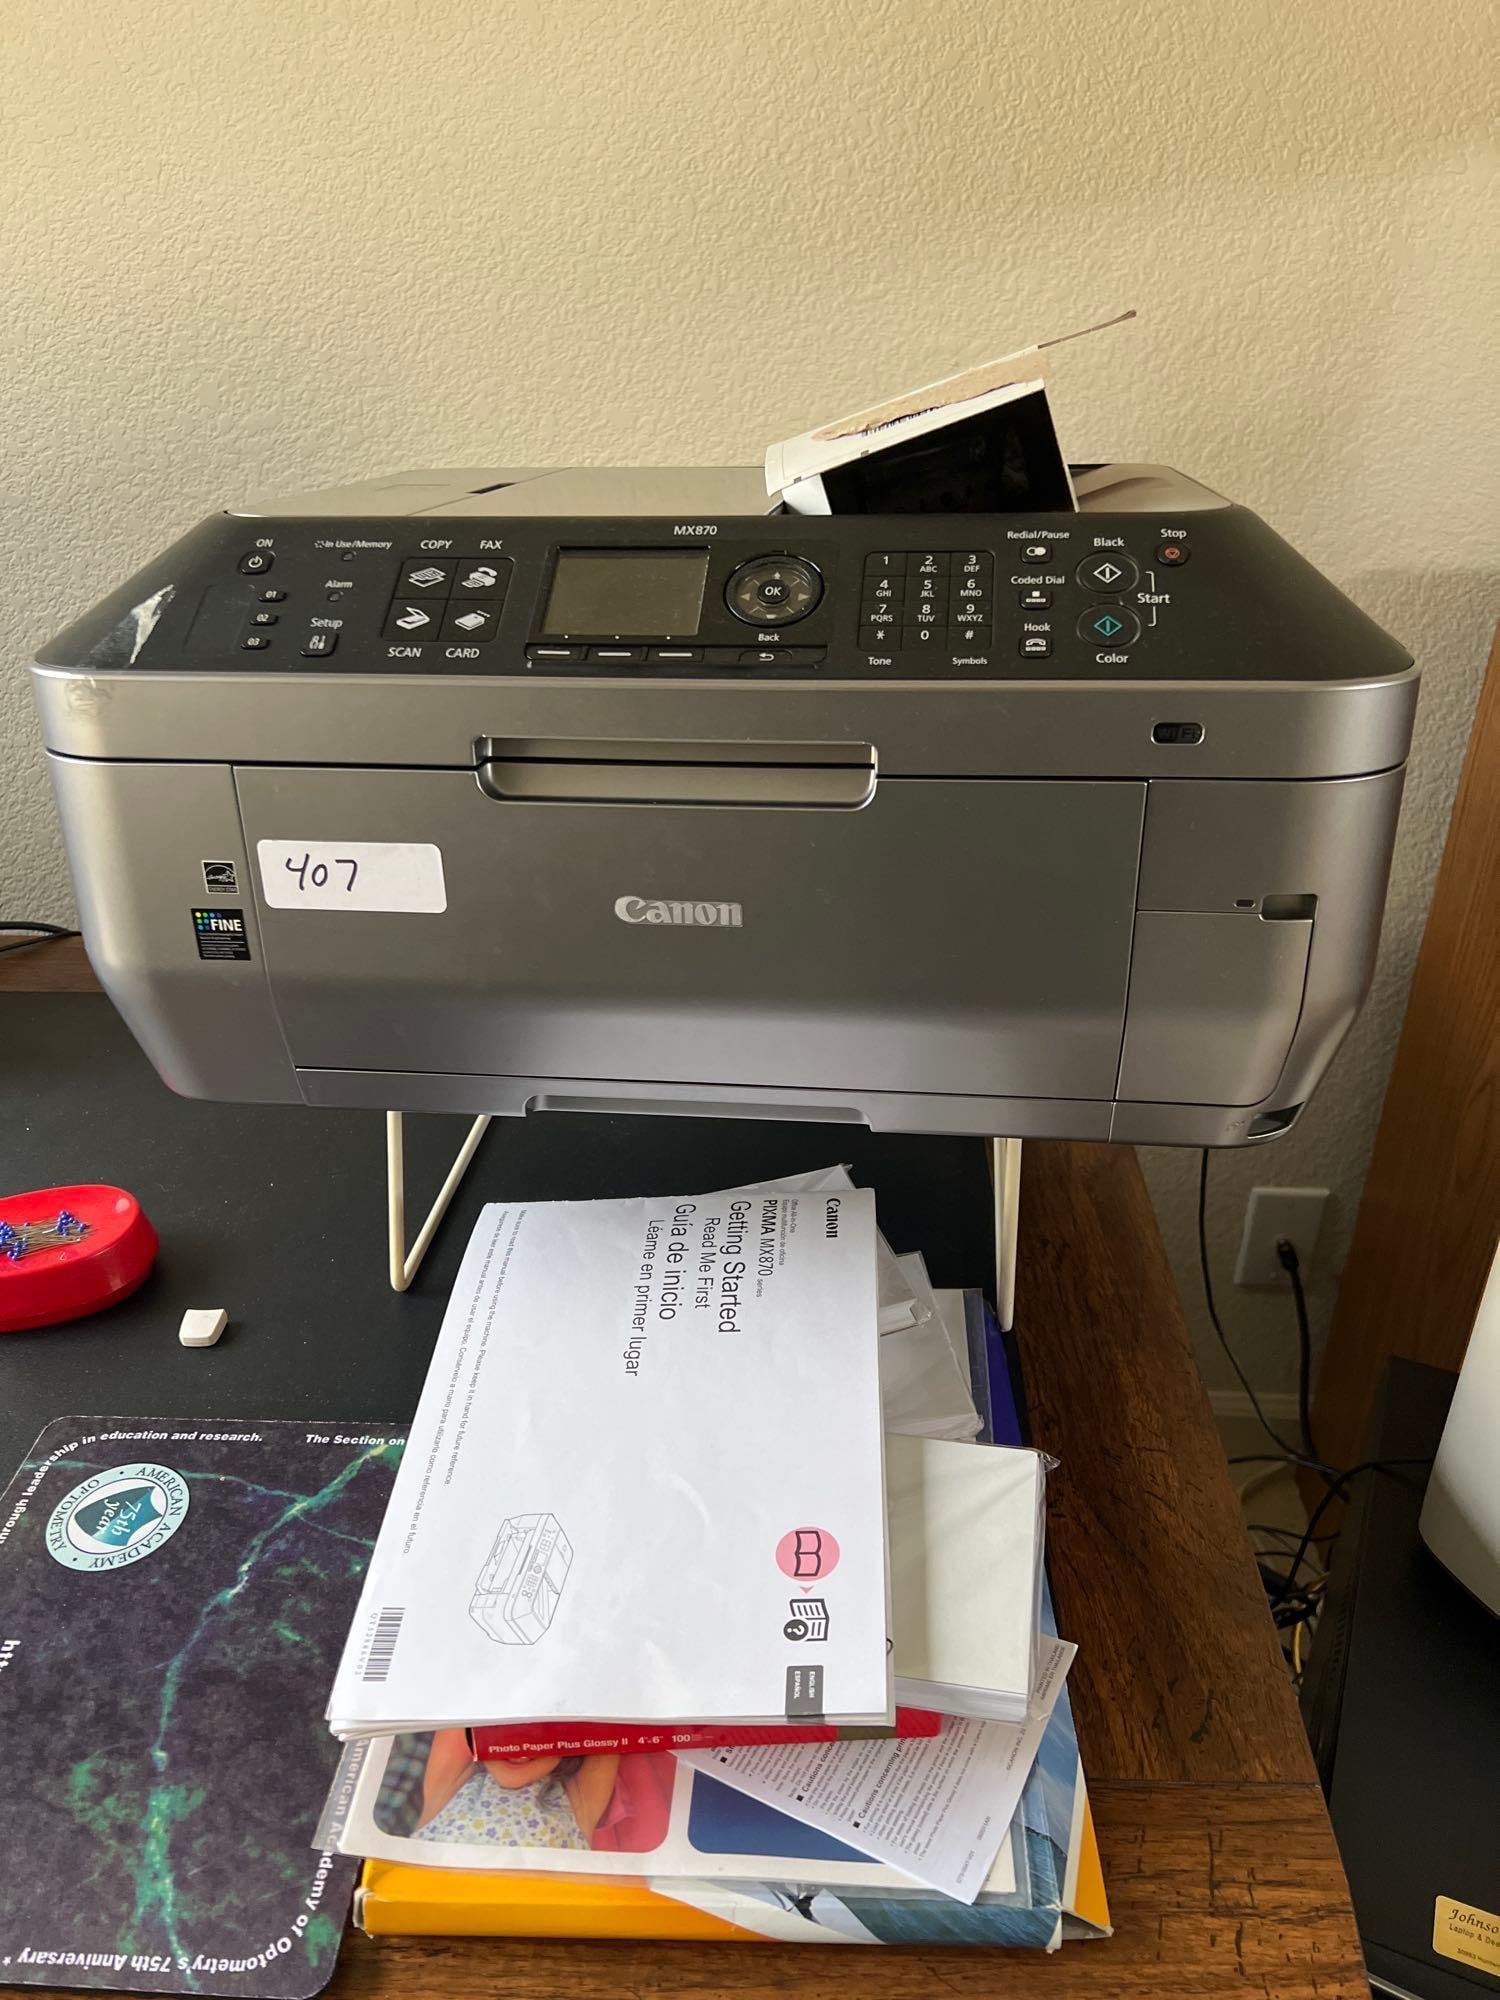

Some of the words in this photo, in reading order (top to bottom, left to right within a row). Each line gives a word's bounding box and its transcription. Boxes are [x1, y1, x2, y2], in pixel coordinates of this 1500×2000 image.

[673, 525, 718, 536] MX870
[1007, 530, 1070, 539] Redial/Pause
[1161, 528, 1187, 539] Stop
[253, 538, 273, 548] ON
[420, 540, 453, 550] COPY
[480, 540, 503, 550] FAX
[1094, 537, 1125, 547] Black
[883, 555, 889, 565] 1
[925, 555, 933, 565] 2
[968, 555, 977, 565] 3
[920, 565, 938, 573] ABC
[964, 565, 980, 573] DEF
[325, 580, 353, 589] Alarm
[880, 579, 888, 589] 4
[924, 580, 932, 590] 5
[967, 579, 976, 589] 6
[1011, 576, 1042, 585] Coded
[1045, 576, 1065, 585] Dial
[765, 586, 782, 596] OK
[876, 590, 892, 598] GHI
[920, 590, 935, 598] JKL
[1137, 593, 1170, 604] Start
[880, 604, 887, 614] 7
[922, 604, 931, 614] 8
[966, 604, 975, 614] 9
[310, 617, 343, 630] Setup
[871, 614, 893, 623] PQRS
[918, 615, 935, 623] TUV
[957, 614, 983, 622] WXYZ
[1024, 623, 1051, 632] Hook
[758, 633, 780, 642] Back
[387, 647, 422, 658] SCAN
[446, 648, 480, 659] CARD
[868, 656, 892, 666] Tone
[952, 656, 988, 666] Symbols
[1096, 653, 1129, 664] Color
[286, 853, 358, 891] 407
[615, 895, 743, 926] Canon
[211, 918, 243, 932] FINE
[671, 1203, 697, 1237] Guía
[761, 1199, 778, 1235] PIXMA
[826, 1198, 841, 1239] Canon
[702, 1217, 721, 1248] Read
[720, 1200, 752, 1255] Getting
[643, 1219, 665, 1260] Léame
[667, 1242, 689, 1264] de
[758, 1238, 775, 1276] MX870
[699, 1252, 717, 1273] Me
[639, 1263, 654, 1280] en
[495, 1276, 506, 1294] before
[695, 1277, 714, 1309] First
[756, 1278, 764, 1298] series
[489, 1294, 500, 1310] using
[659, 1269, 687, 1320] inicio
[718, 1261, 746, 1333] Started
[470, 1303, 478, 1317] usar
[487, 1310, 497, 1320] the
[632, 1285, 653, 1332] primer
[461, 1324, 472, 1346] equipo.
[474, 1349, 487, 1371] Please
[623, 1336, 647, 1377] lugar
[469, 1372, 481, 1389] keep
[444, 1389, 456, 1408] mano
[438, 1409, 450, 1424] para
[461, 1402, 473, 1419] hand
[459, 1420, 469, 1430] for
[306, 1434, 330, 1444] The
[333, 1435, 385, 1445] Section
[389, 1438, 405, 1446] on
[432, 1425, 447, 1454] utilizarlo
[453, 1430, 466, 1450] future
[22, 1441, 79, 1496] leadership
[82, 1436, 96, 1445] in
[100, 1430, 168, 1441] education
[171, 1431, 198, 1441] and
[199, 1433, 263, 1442] research.
[426, 1454, 438, 1474] como
[136, 1466, 184, 1516] AMERICAN
[415, 1474, 433, 1511] referencia
[51, 1478, 101, 1552] OPTOMETRY
[96, 1498, 120, 1536] year
[112, 1500, 142, 1536] 75th
[89, 1522, 172, 1569] ACADEMY
[793, 1670, 802, 1699] ESPAÑOL
[489, 1744, 520, 1753] Photo
[523, 1743, 555, 1753] Paper
[558, 1740, 581, 1749] Plus
[584, 1737, 619, 1748] Glossy
[672, 1734, 691, 1743] 100
[801, 1762, 823, 1793] Cautions
[858, 1788, 879, 1819] Cautions
[876, 1751, 900, 1789] concerning
[291, 1914, 309, 1938] of
[1448, 1908, 1500, 1935] Johnso
[1449, 1922, 1475, 1939] Laptop
[17, 1947, 125, 1971] Anniversary
[132, 1952, 172, 1973] 75th
[177, 1937, 292, 1974] Optometry's
